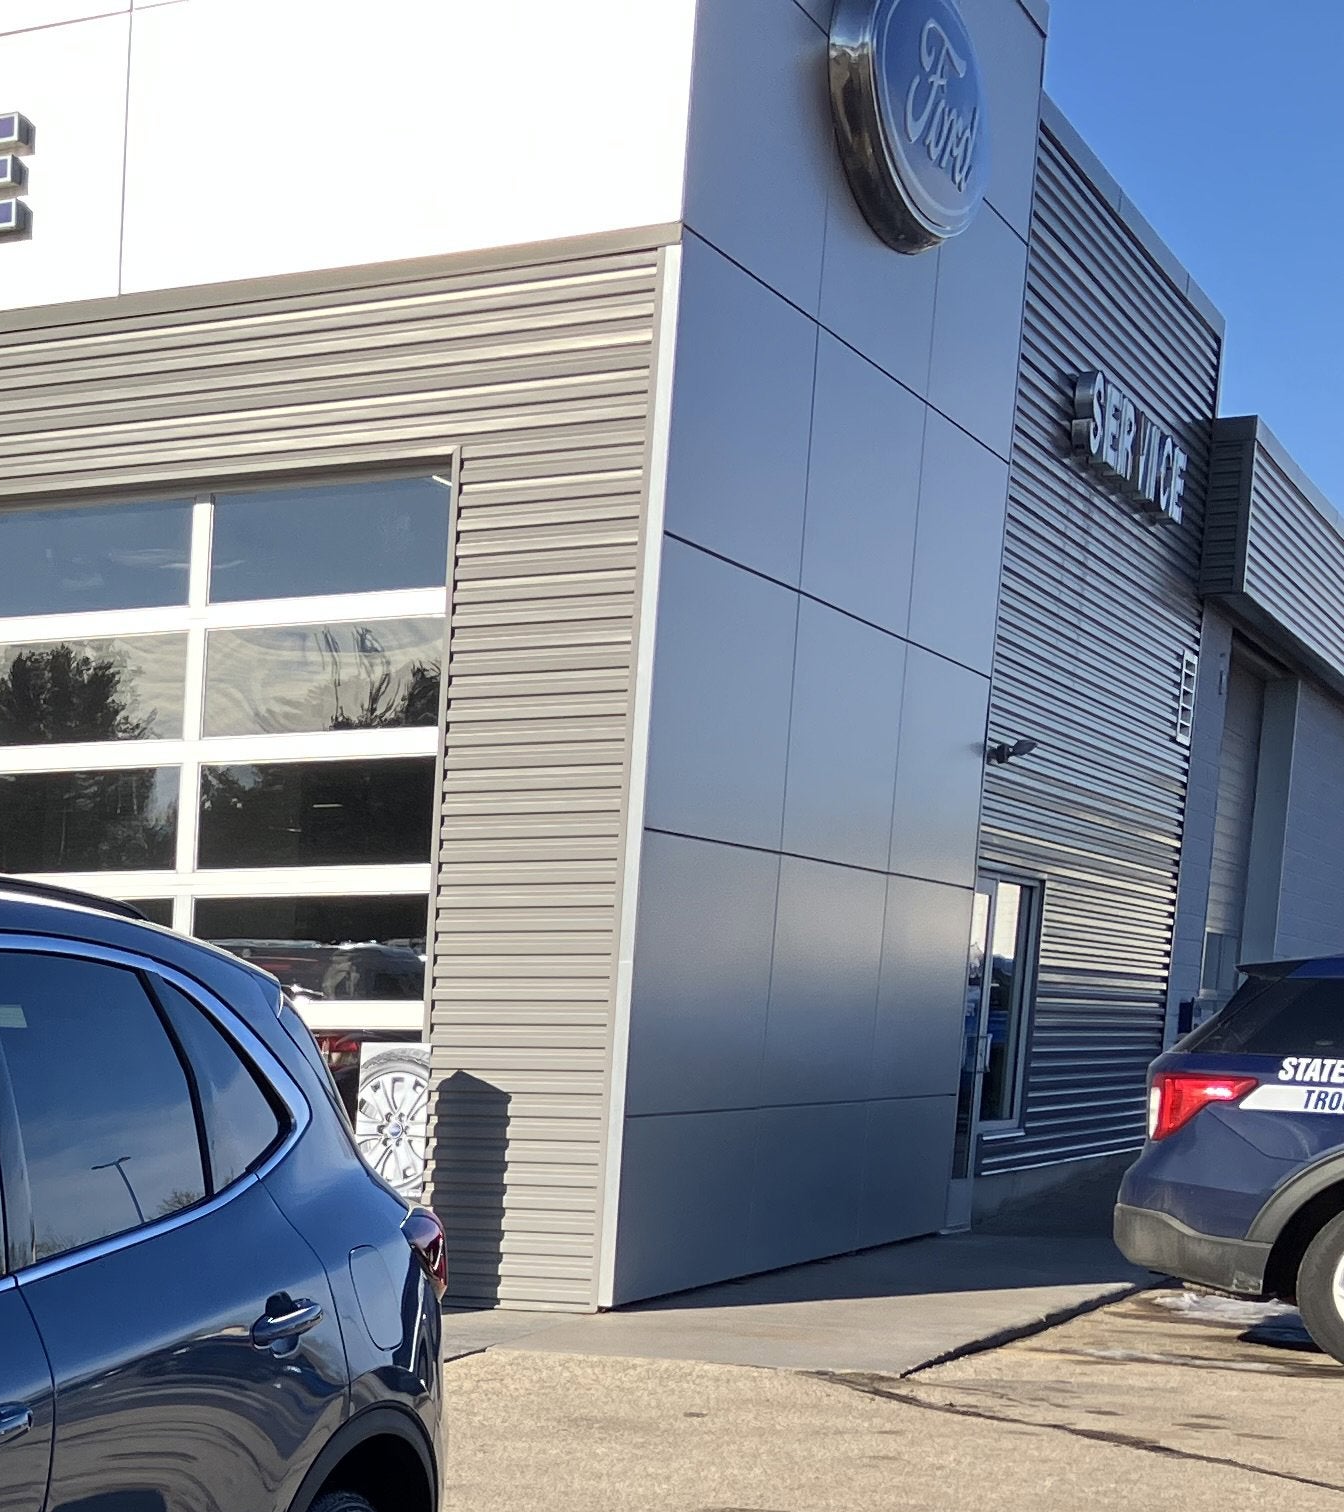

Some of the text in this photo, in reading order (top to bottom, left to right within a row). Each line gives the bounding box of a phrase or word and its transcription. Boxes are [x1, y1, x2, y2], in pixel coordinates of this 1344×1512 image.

[906, 18, 980, 194] Ford
[1087, 371, 1188, 525] SERVICE
[1277, 1056, 1344, 1084] STATE
[1303, 1089, 1344, 1112] TRO
